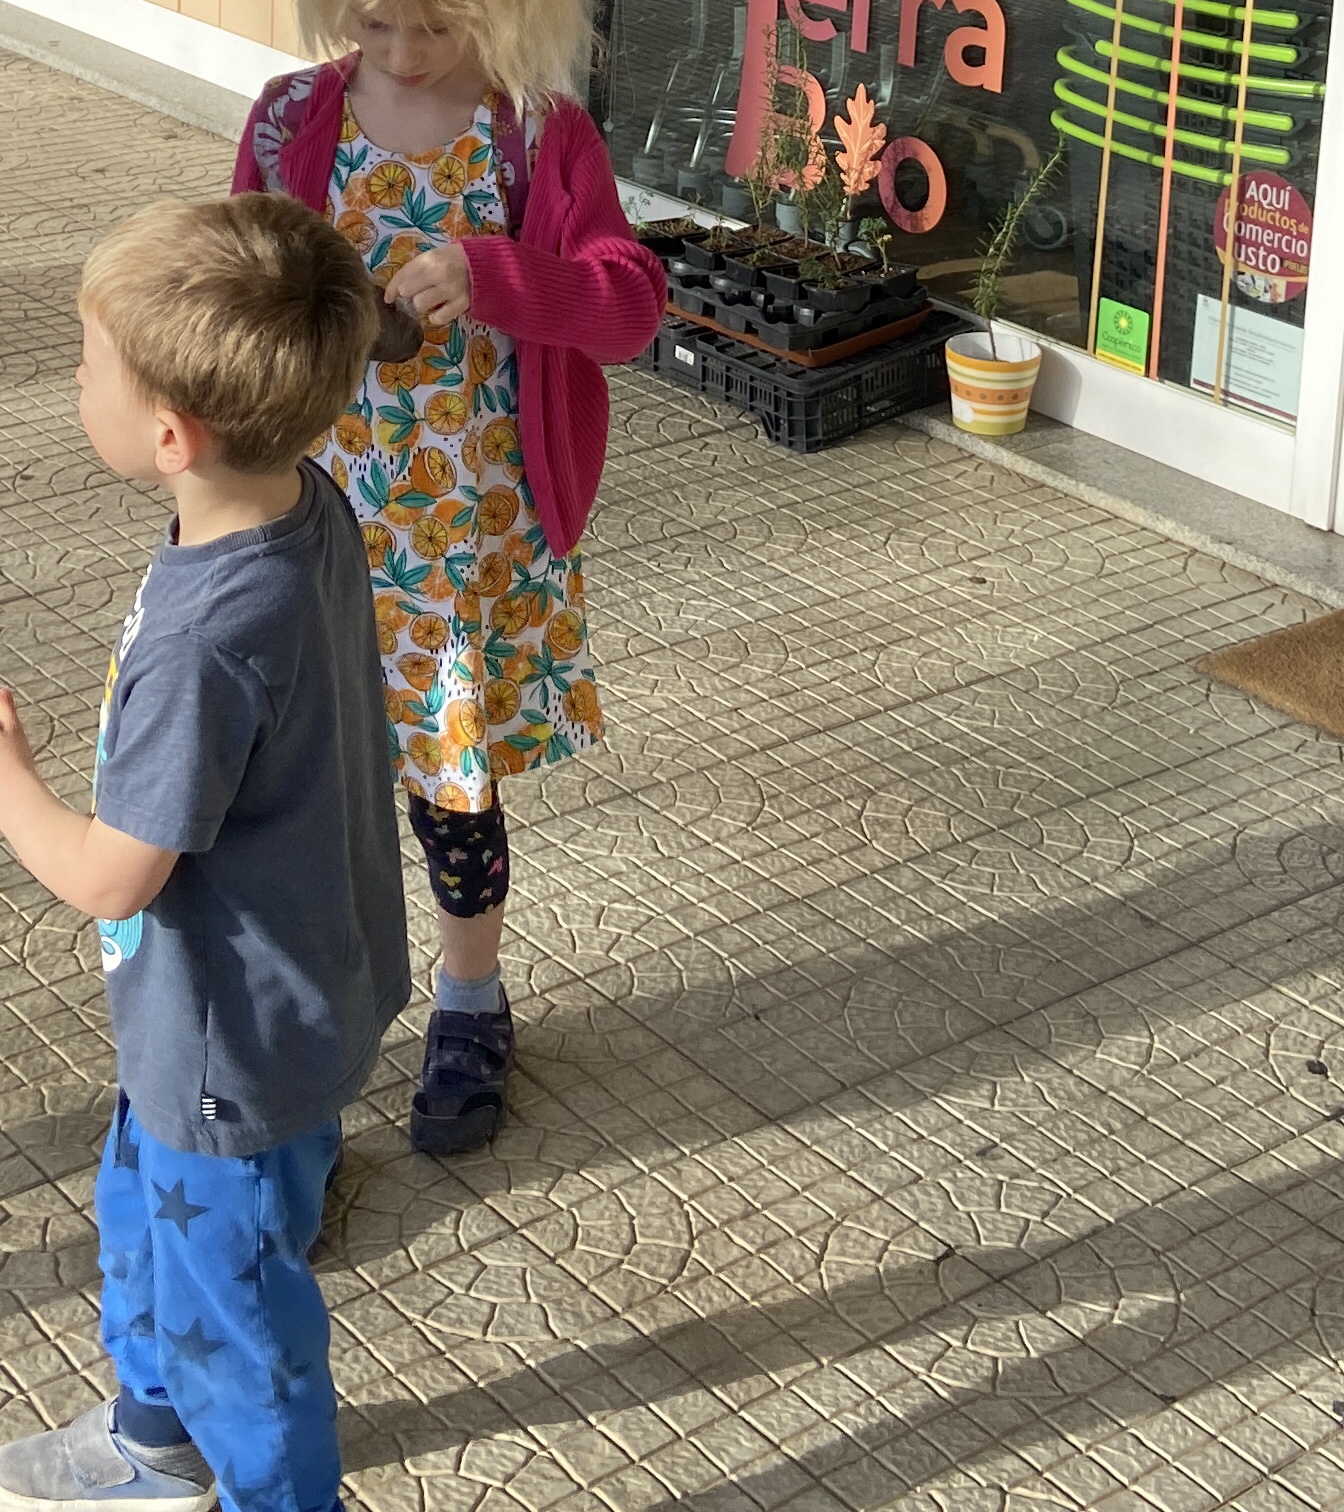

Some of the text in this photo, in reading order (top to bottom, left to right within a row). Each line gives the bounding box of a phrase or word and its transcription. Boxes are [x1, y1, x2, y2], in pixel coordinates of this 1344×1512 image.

[1245, 180, 1291, 210] AQUÍ
[1298, 222, 1309, 235] de
[1229, 242, 1281, 274] usto
